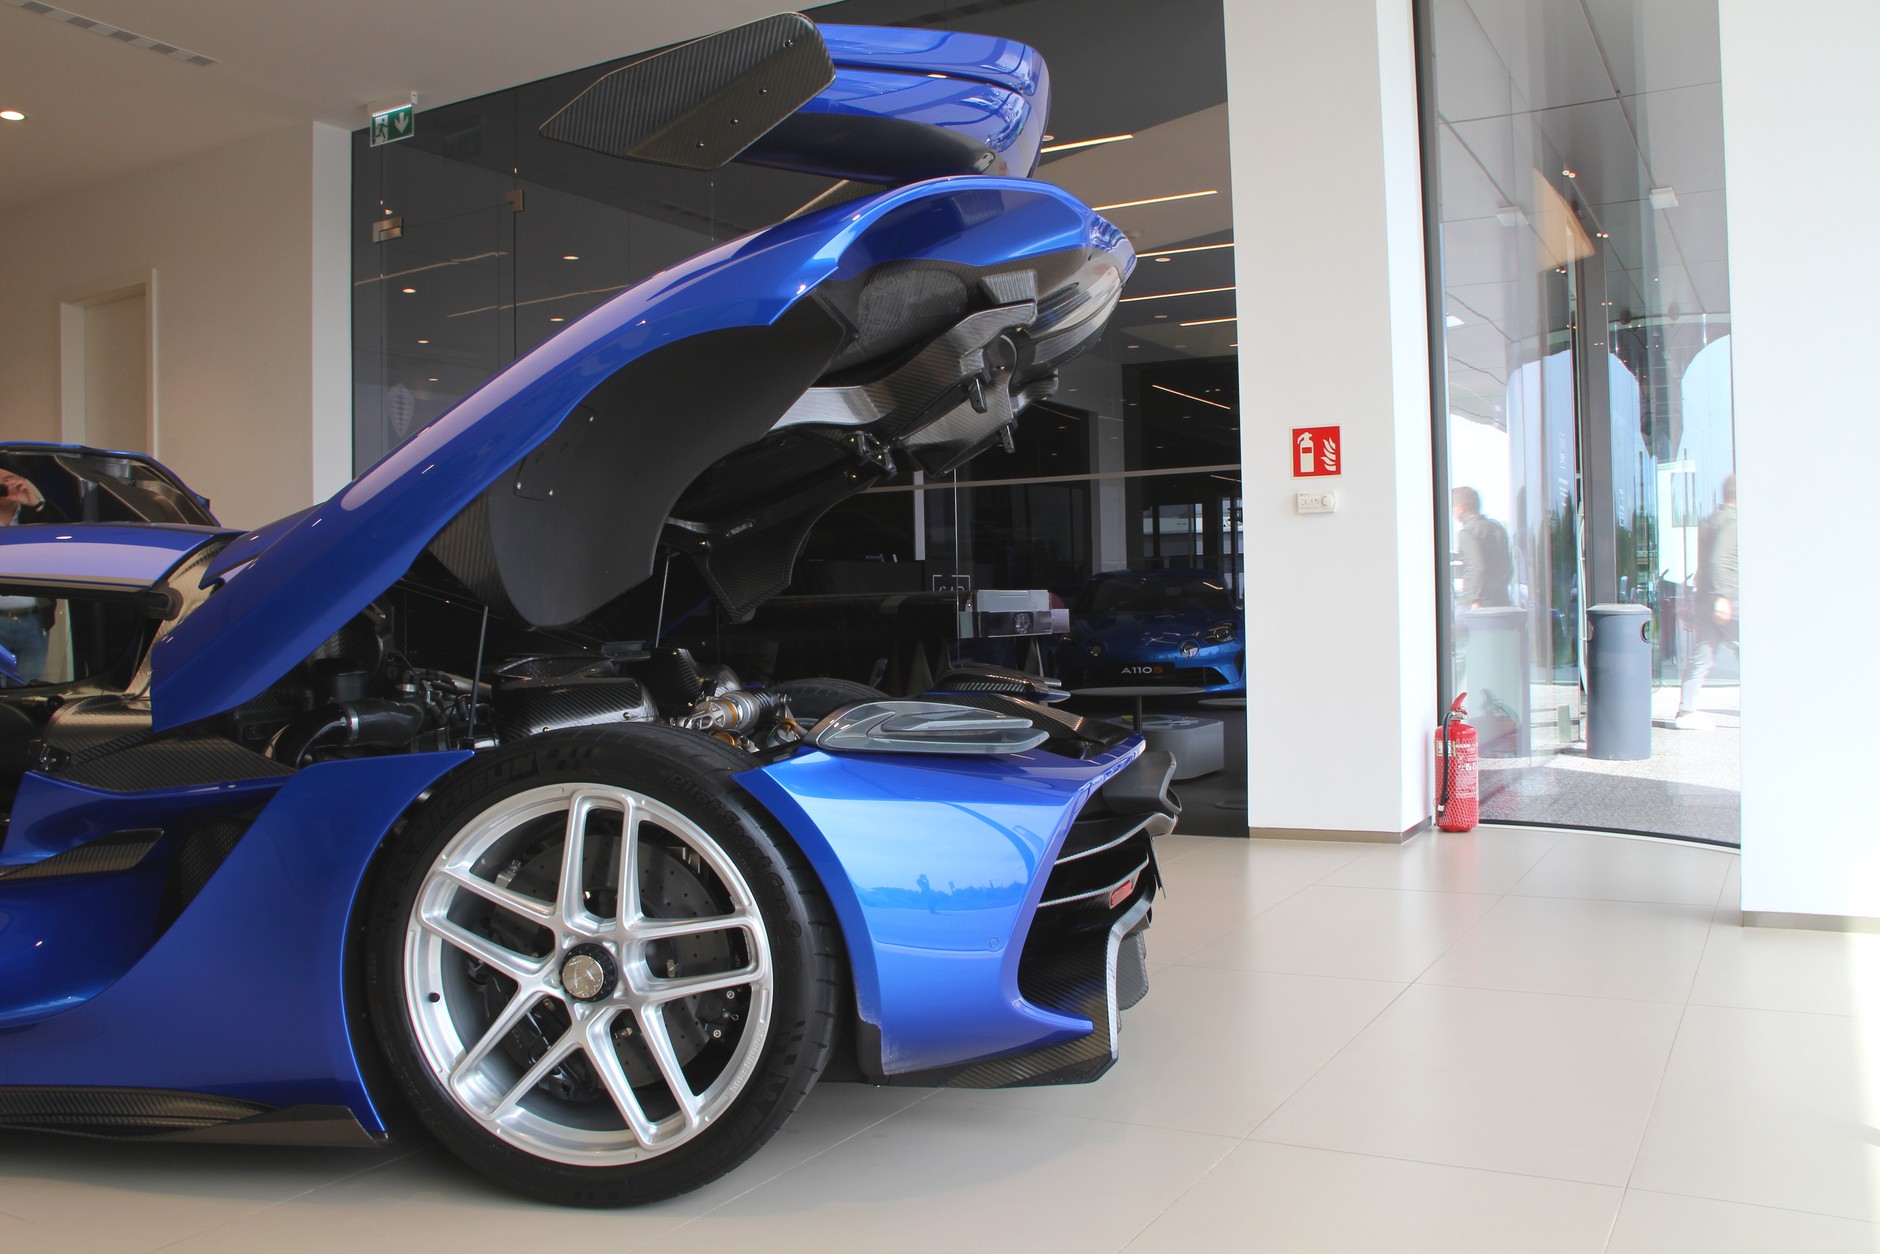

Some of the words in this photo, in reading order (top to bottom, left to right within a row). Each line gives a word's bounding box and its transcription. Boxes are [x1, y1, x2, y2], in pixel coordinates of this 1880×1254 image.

[411, 754, 534, 850] MICHELIN
[667, 771, 723, 816] Pilot
[718, 808, 773, 872] Sport
[766, 872, 791, 917] Cup
